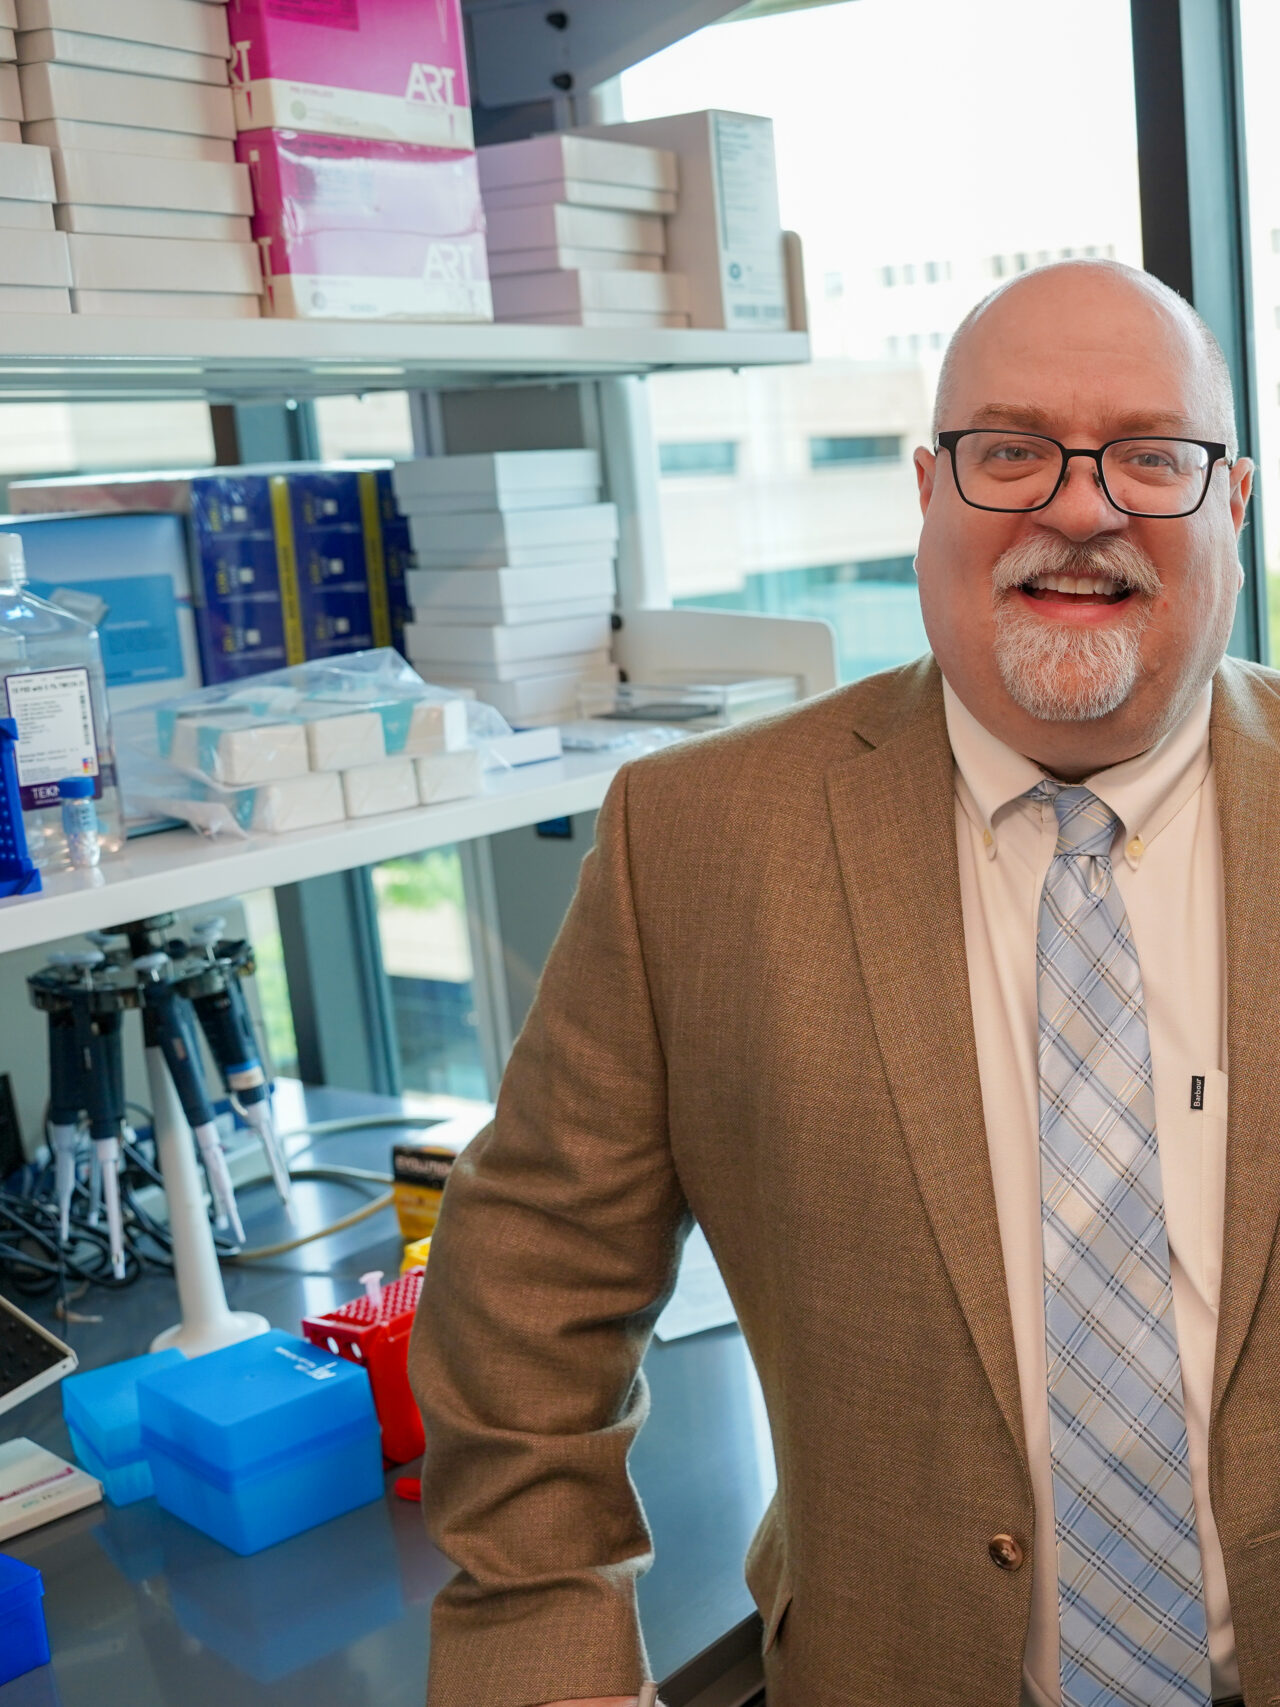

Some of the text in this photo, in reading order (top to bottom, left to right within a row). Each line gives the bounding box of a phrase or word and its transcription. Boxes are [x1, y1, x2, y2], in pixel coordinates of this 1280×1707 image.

[229, 40, 252, 87] RT
[405, 62, 455, 107] ART
[423, 243, 473, 286] ART
[31, 785, 61, 800] TEKN
[1193, 1078, 1202, 1107] Barbour
